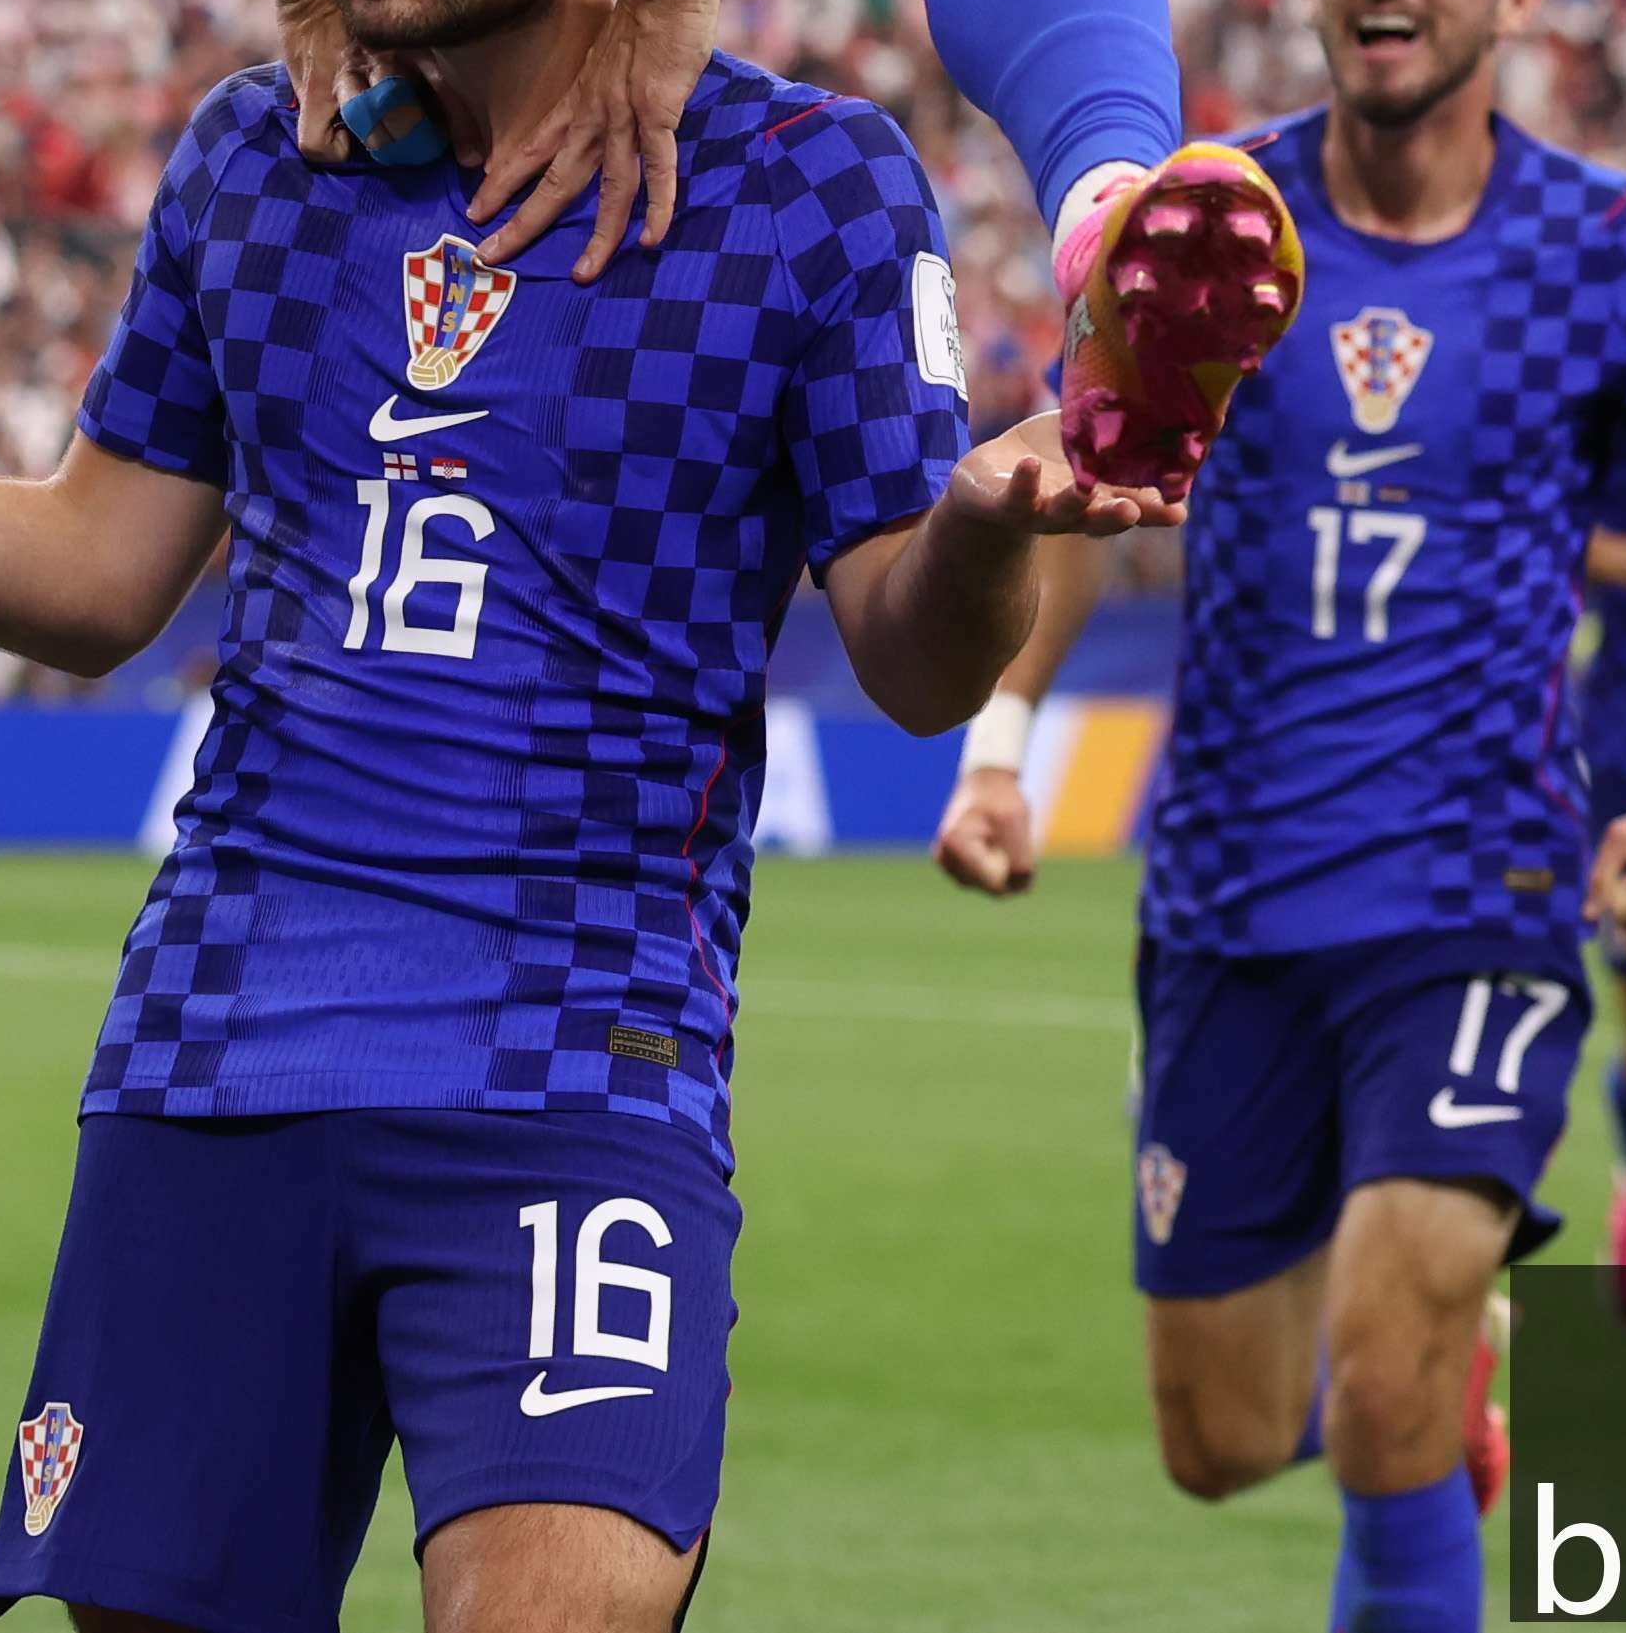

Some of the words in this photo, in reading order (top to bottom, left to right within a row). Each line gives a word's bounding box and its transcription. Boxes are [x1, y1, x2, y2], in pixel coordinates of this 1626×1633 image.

[343, 480, 495, 659] 16
[1308, 507, 1428, 643] 17
[1448, 979, 1568, 1094] 17
[520, 1197, 673, 1373] 16
